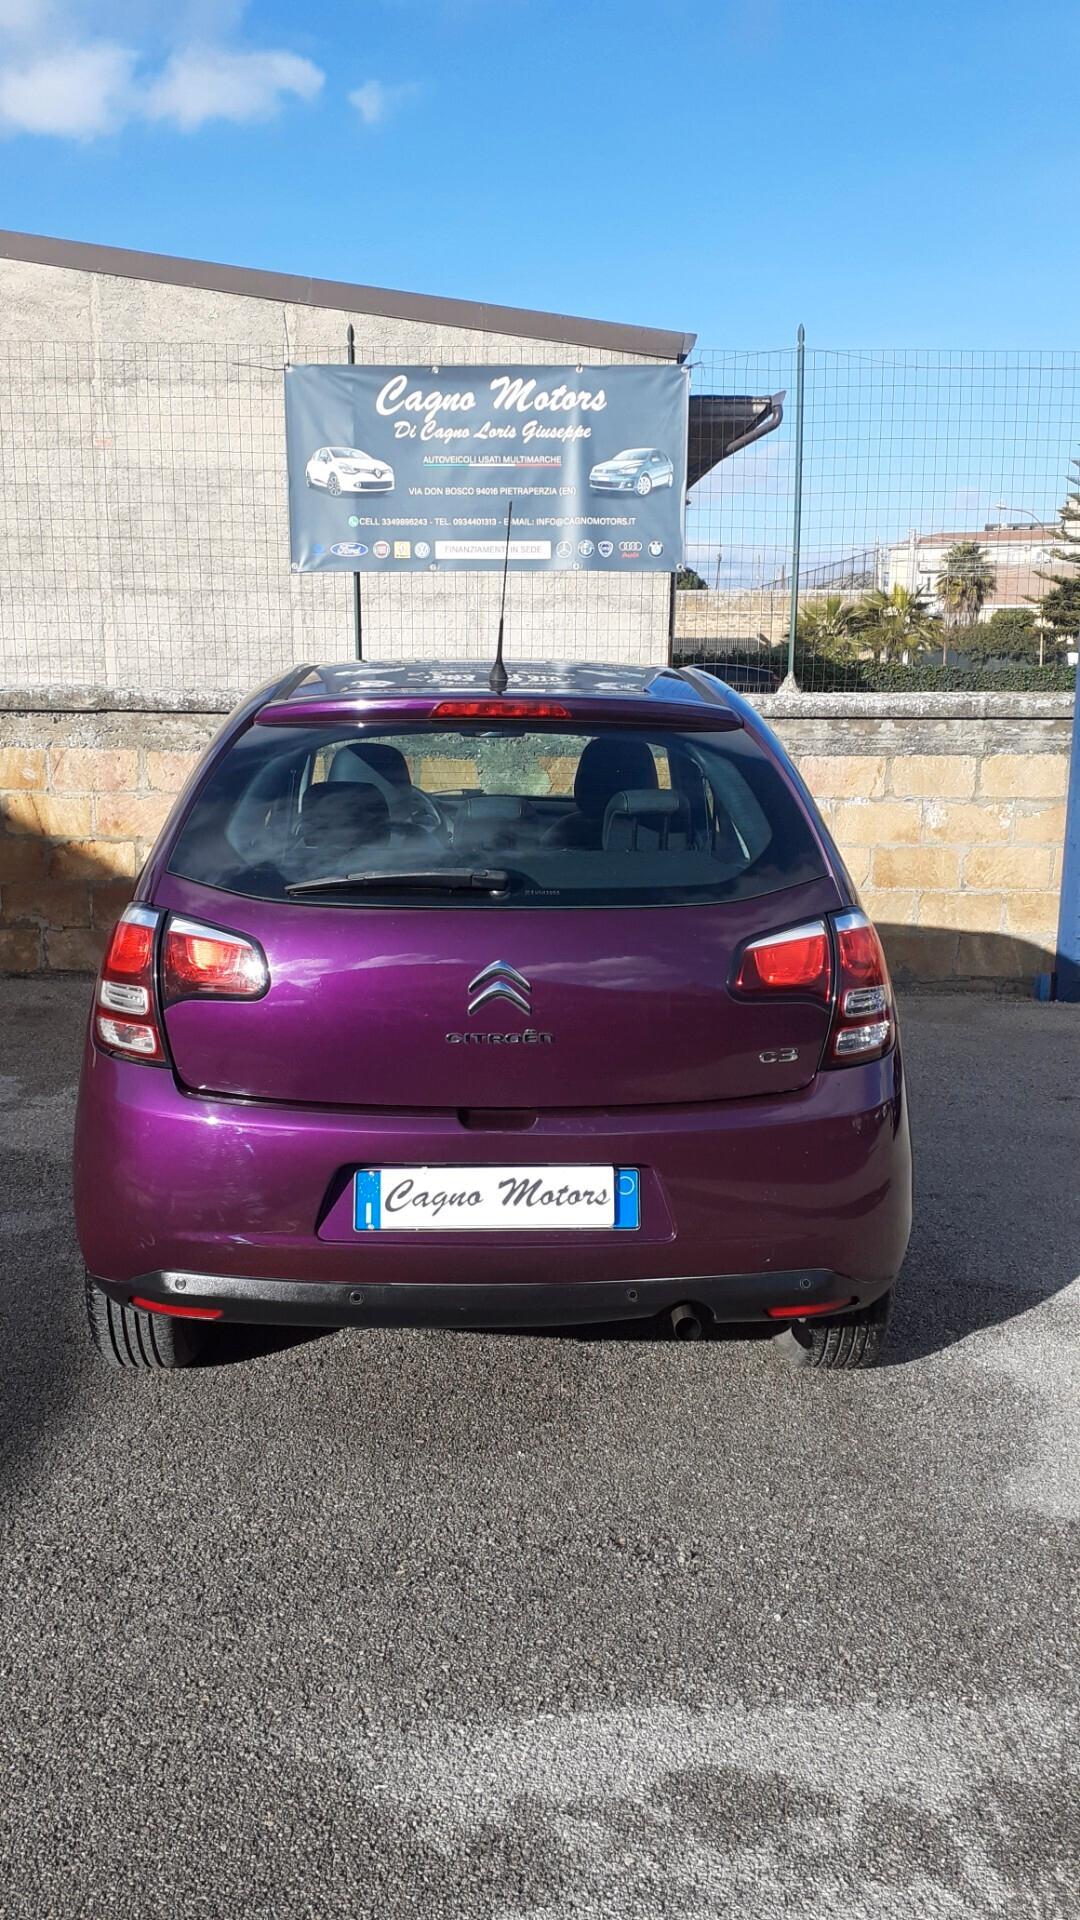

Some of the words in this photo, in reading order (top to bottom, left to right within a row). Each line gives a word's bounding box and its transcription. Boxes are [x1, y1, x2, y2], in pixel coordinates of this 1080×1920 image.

[375, 374, 477, 423] Cagno
[490, 376, 607, 412] Motors
[394, 421, 417, 439] Di
[420, 420, 470, 444] Cagno
[473, 421, 517, 440] Loris
[522, 420, 592, 444] Giuseppe
[423, 456, 477, 464] AUTOVEICOLI
[478, 456, 501, 464] USATI
[503, 456, 562, 464] MULTIMARCHE
[408, 487, 423, 496] VIA
[424, 487, 444, 496] DON
[445, 487, 475, 496] BOSCO
[476, 487, 498, 496] 94016
[500, 487, 557, 496] PIETRAPERZIA
[559, 486, 577, 497] (EN)
[359, 517, 380, 526] CELL
[536, 516, 637, 527] INFO@CAGNOMOTORS.IT
[444, 545, 509, 554] FINANZIAMENT
[511, 545, 519, 554] IN
[521, 545, 543, 554] SEDE
[759, 1048, 799, 1063] C3
[384, 1178, 484, 1217] Cagno
[498, 1177, 611, 1208] Motors
